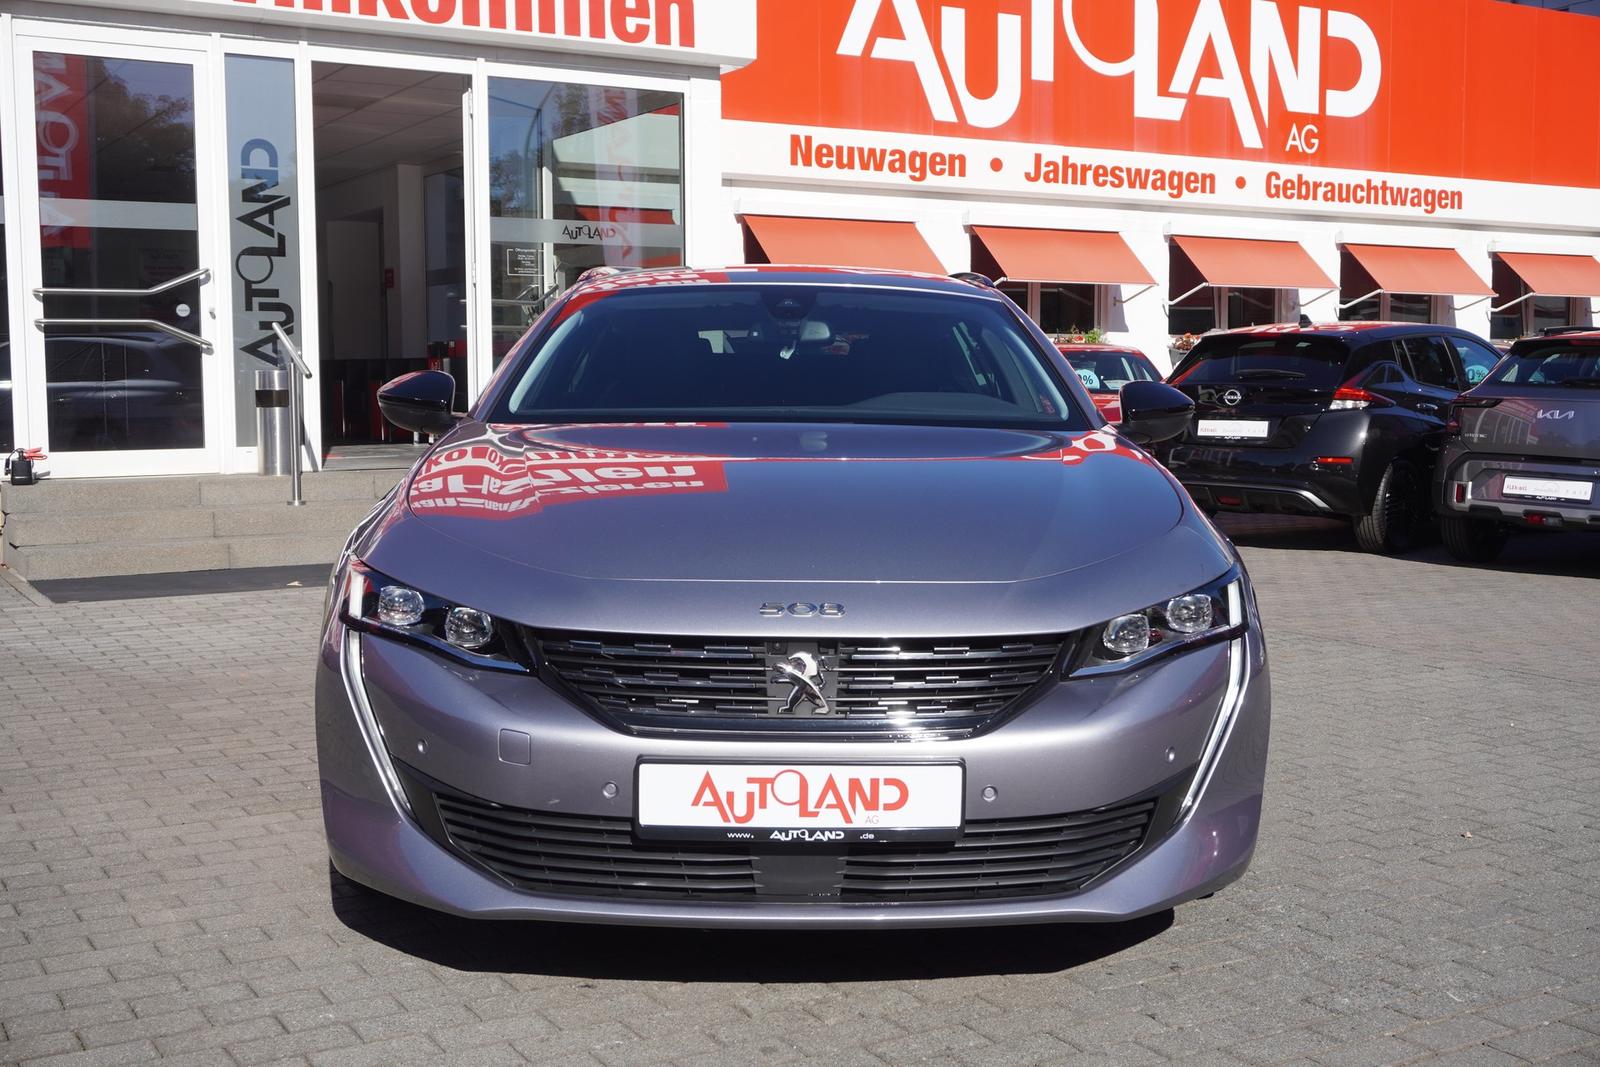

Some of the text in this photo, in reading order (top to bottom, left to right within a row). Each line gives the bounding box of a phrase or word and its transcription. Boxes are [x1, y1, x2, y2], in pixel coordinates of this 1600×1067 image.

[1285, 122, 1320, 155] AG
[789, 133, 1463, 214] Neuwagen Jahreswagen Gebrauchtwagen
[236, 138, 294, 370] AUTOLAND
[759, 602, 847, 617] 508
[690, 769, 910, 824] AUTOLAND
[859, 831, 875, 840] .de
[864, 815, 880, 825] AG
